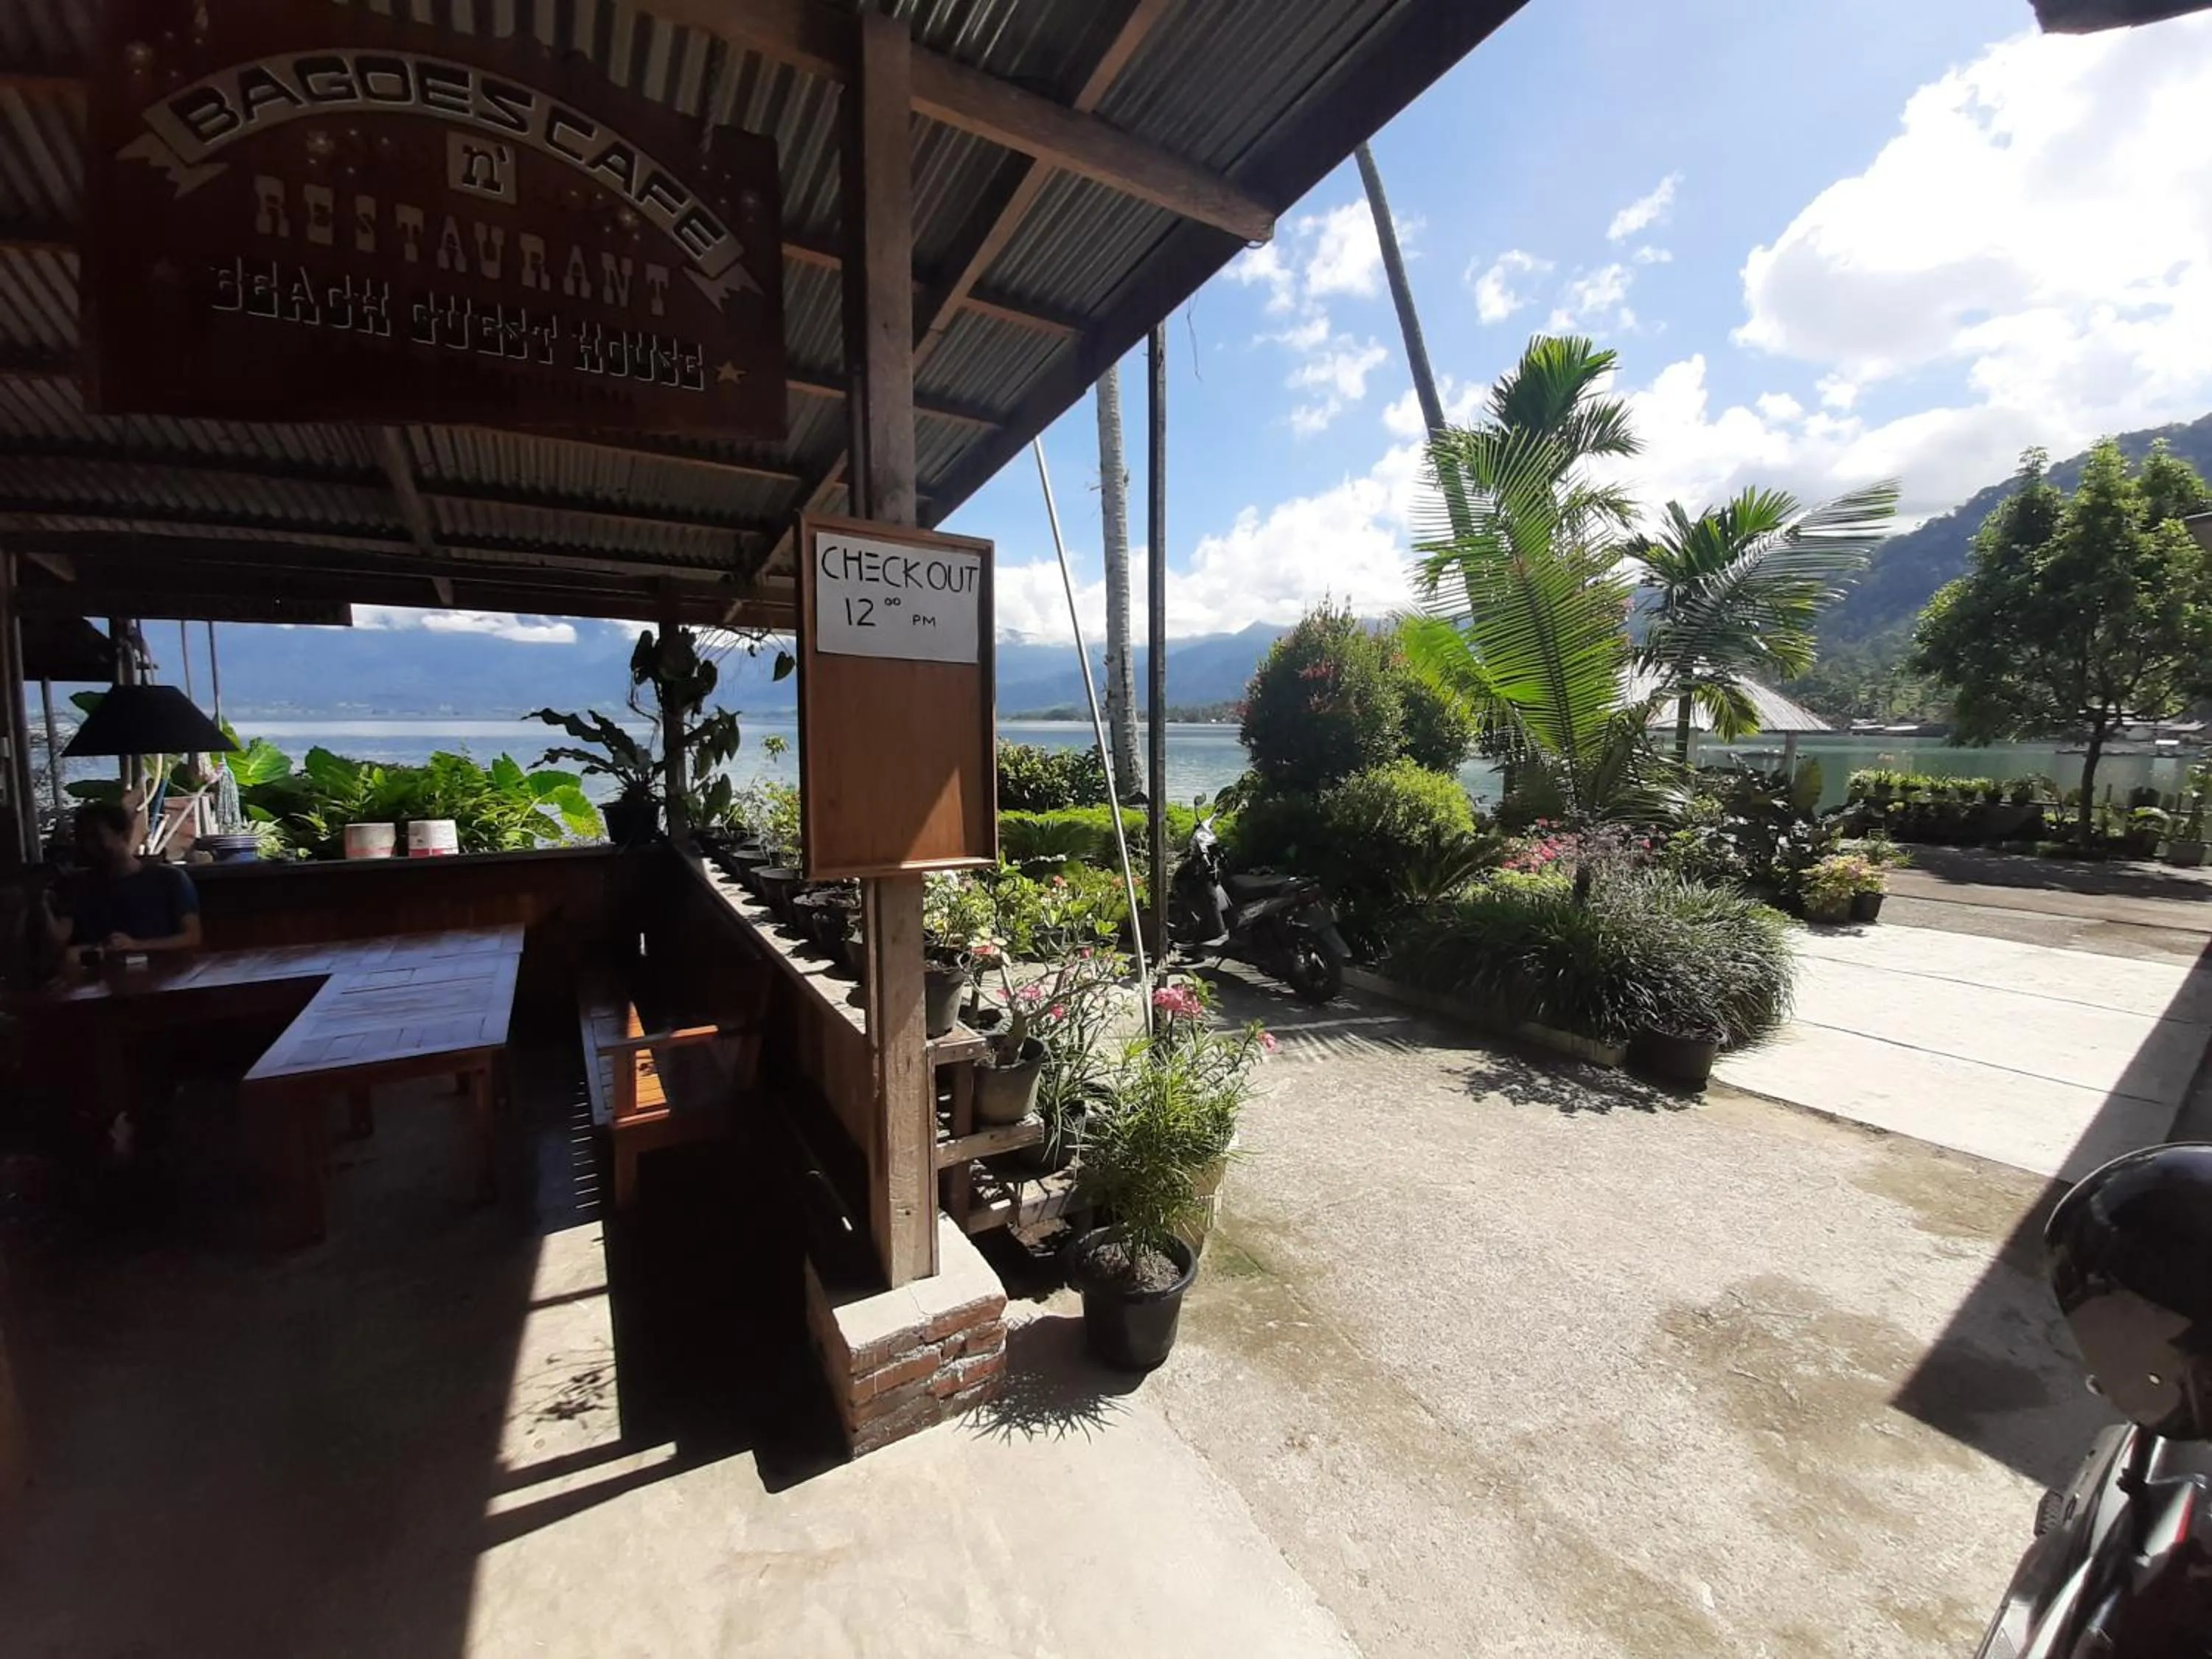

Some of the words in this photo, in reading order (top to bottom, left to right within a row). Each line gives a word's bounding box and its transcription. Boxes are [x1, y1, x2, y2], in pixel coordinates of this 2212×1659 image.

[168, 56, 535, 145] BAGOES
[544, 105, 728, 260] CAFE
[253, 174, 669, 317] RESTAURANT
[209, 257, 390, 337] BEACH
[411, 291, 557, 365] GUEST
[571, 319, 704, 392] HOUSE
[912, 614, 936, 627] PM
